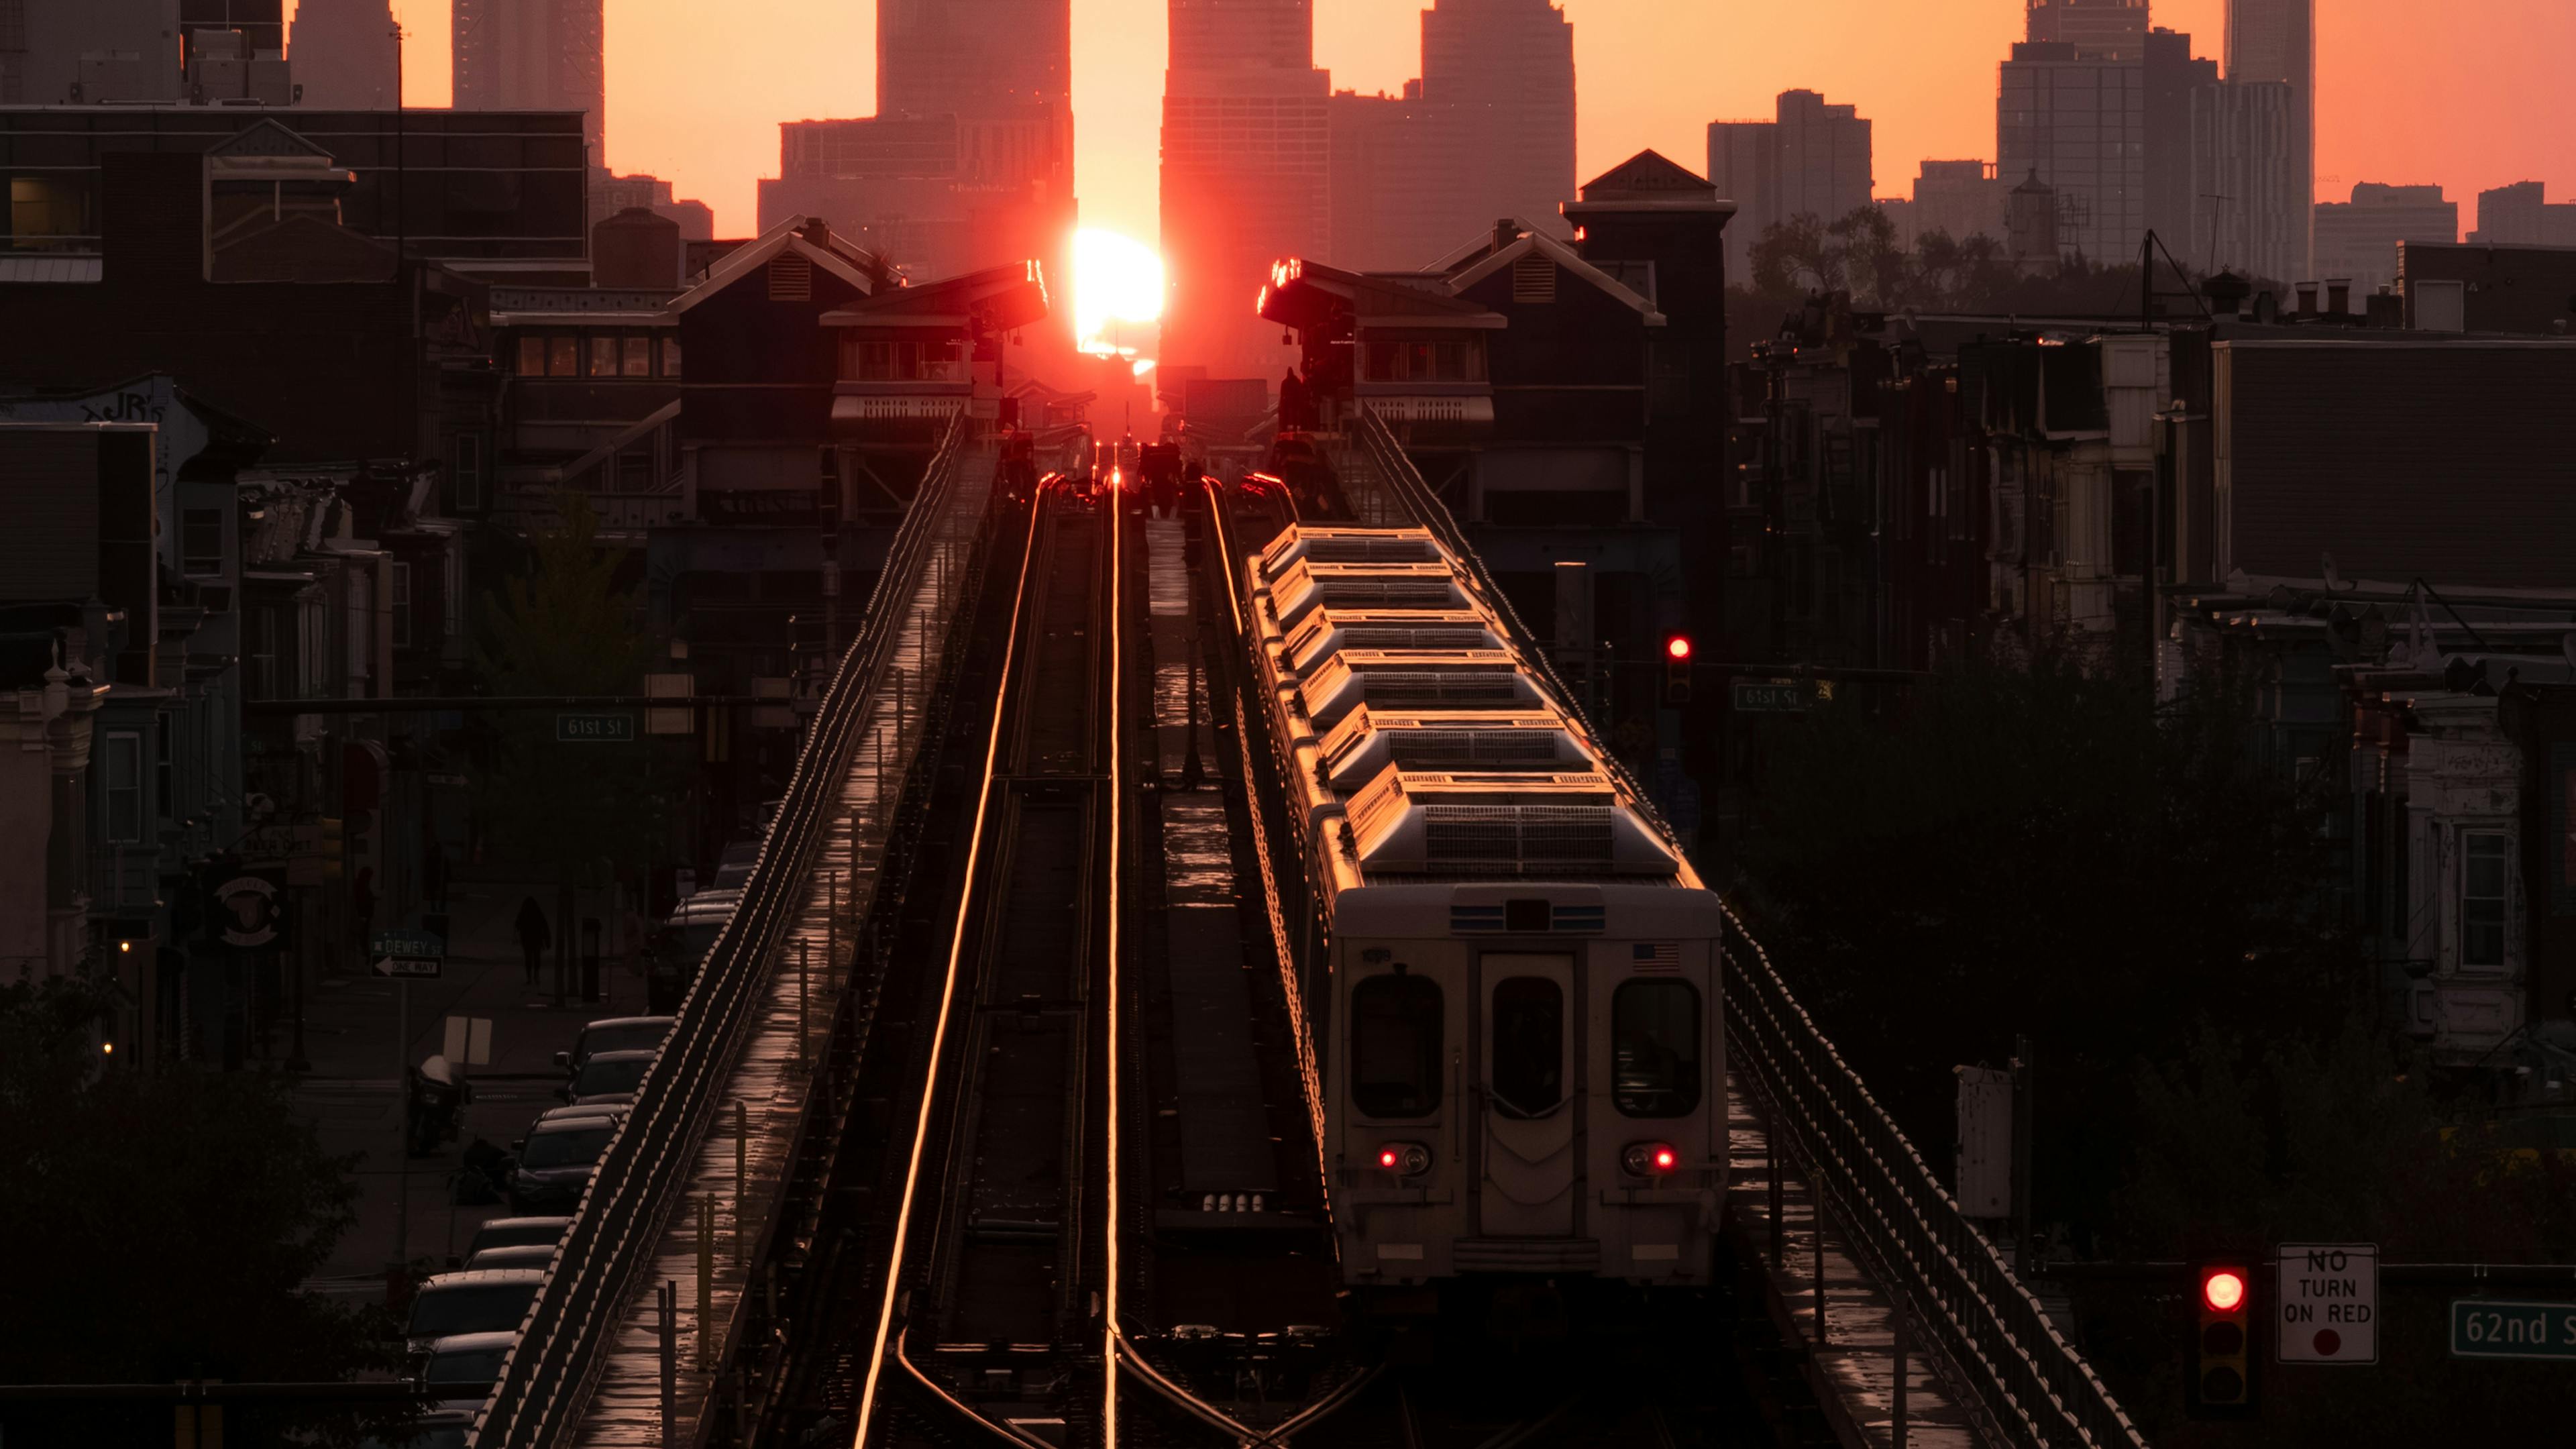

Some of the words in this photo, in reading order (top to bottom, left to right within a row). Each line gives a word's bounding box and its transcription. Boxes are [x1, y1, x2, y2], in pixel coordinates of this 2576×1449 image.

[568, 718, 601, 735] 61st
[606, 718, 622, 735] St
[385, 939, 428, 955] DEWEY
[392, 961, 411, 971] ONE
[414, 961, 435, 973] WAY
[2308, 1250, 2347, 1272] NO
[2299, 1279, 2356, 1297] TURN
[2284, 1303, 2313, 1324] ON
[2328, 1303, 2371, 1324] RED
[2467, 1311, 2547, 1344] 62nd
